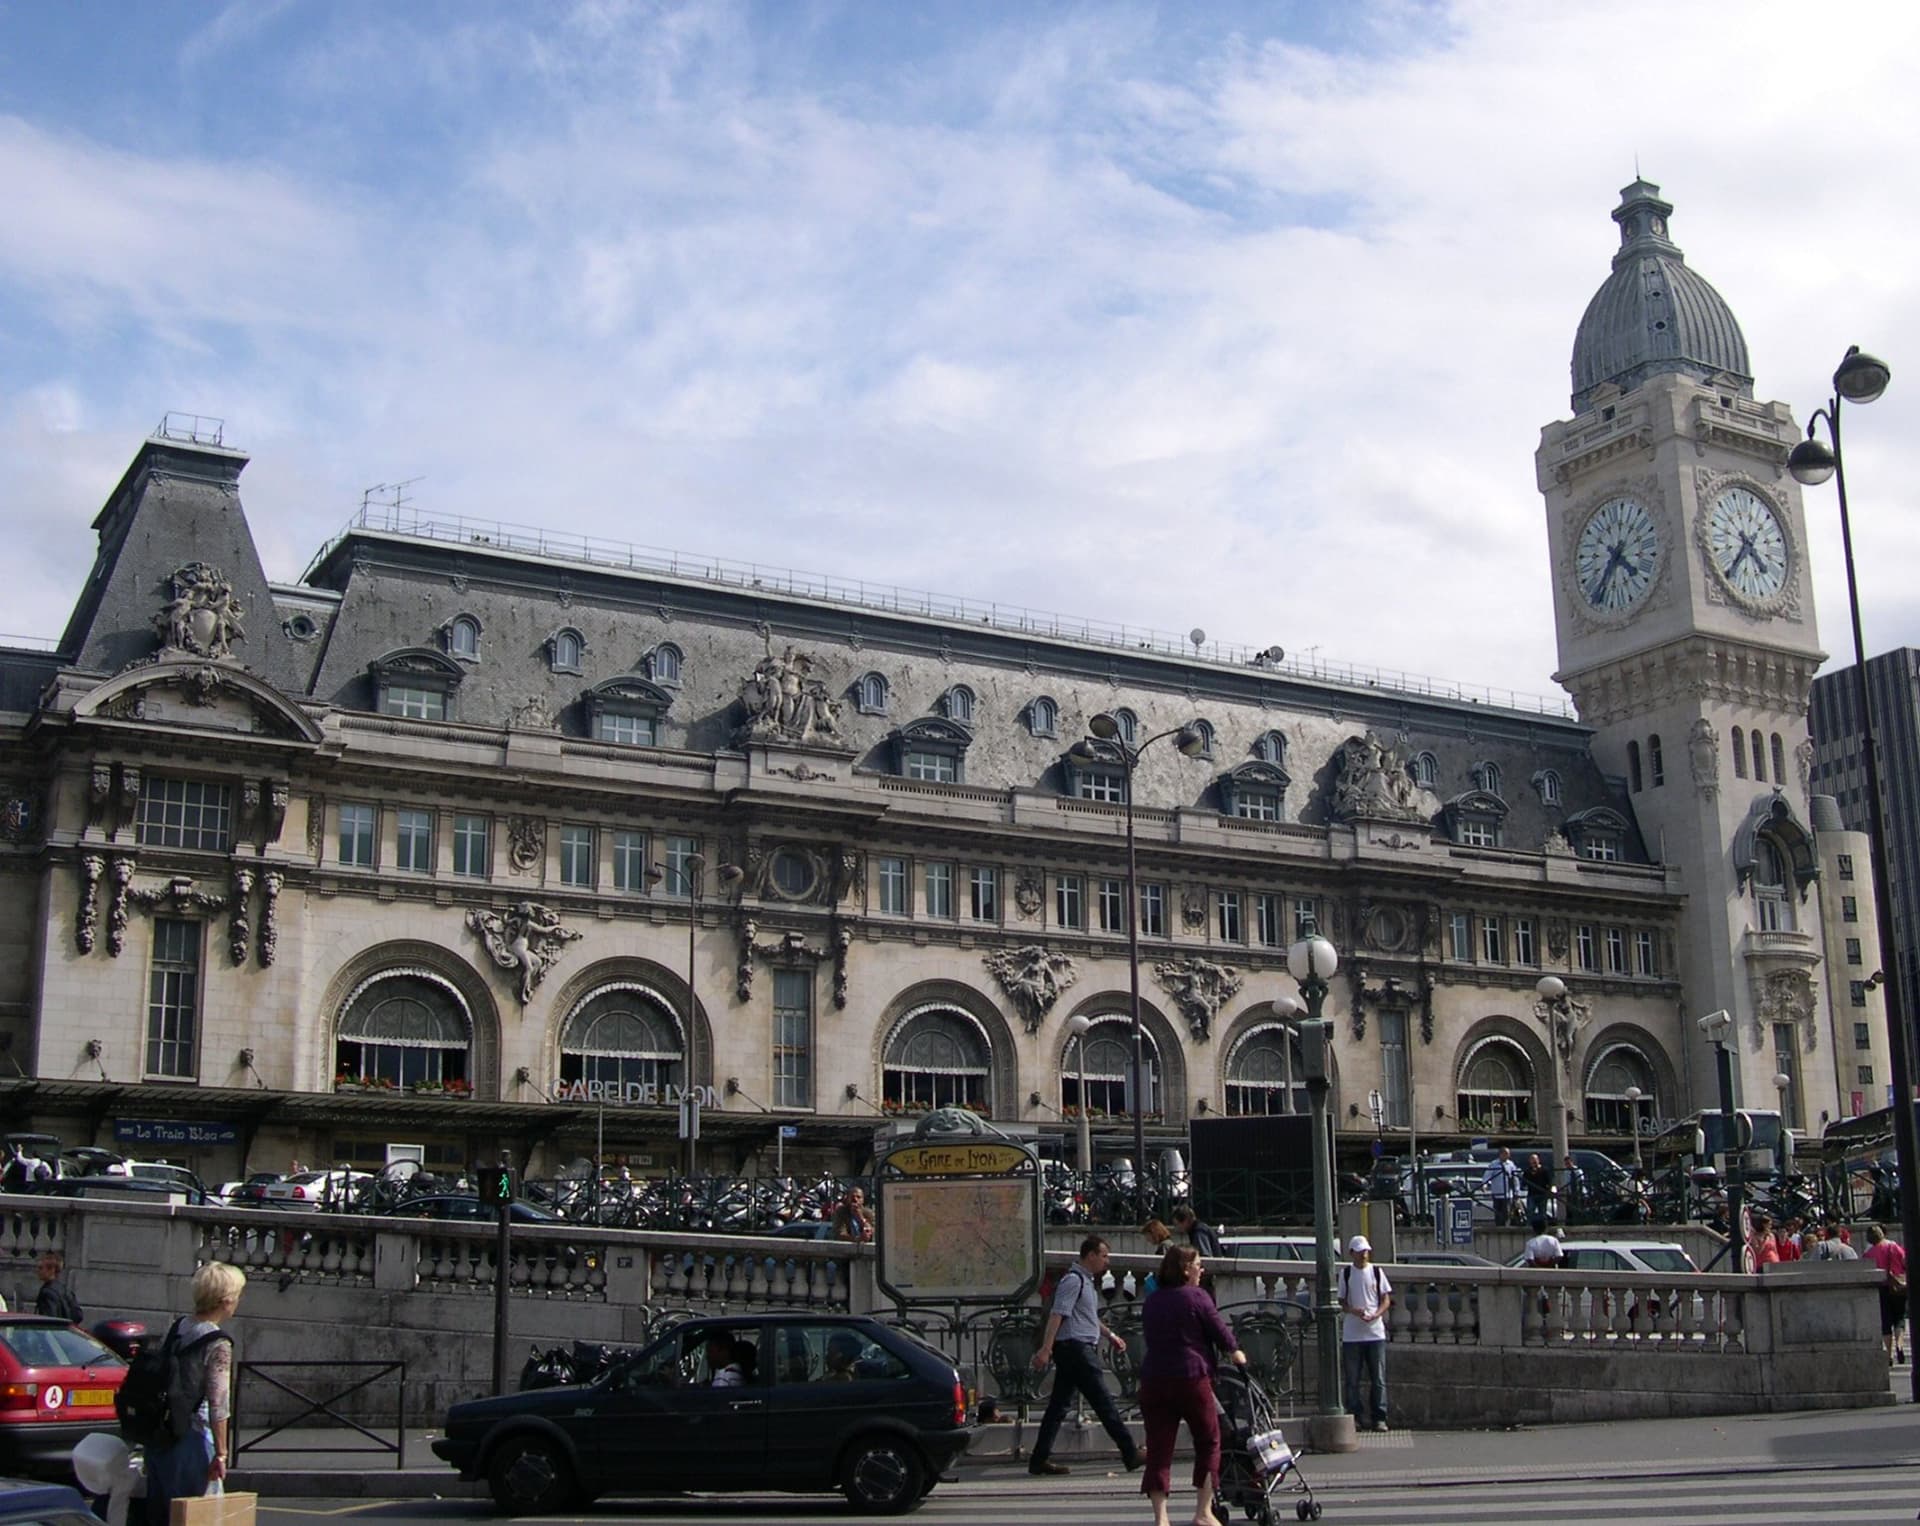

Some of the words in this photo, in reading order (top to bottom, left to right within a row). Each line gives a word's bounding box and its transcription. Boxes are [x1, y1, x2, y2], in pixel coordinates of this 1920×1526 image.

[551, 1078, 618, 1103] GARE
[625, 1082, 657, 1104] DE
[665, 1084, 724, 1110] LYON
[136, 1124, 151, 1138] Le
[154, 1125, 185, 1140] Train
[189, 1126, 217, 1141] Bleu
[49, 1388, 57, 1404] A
